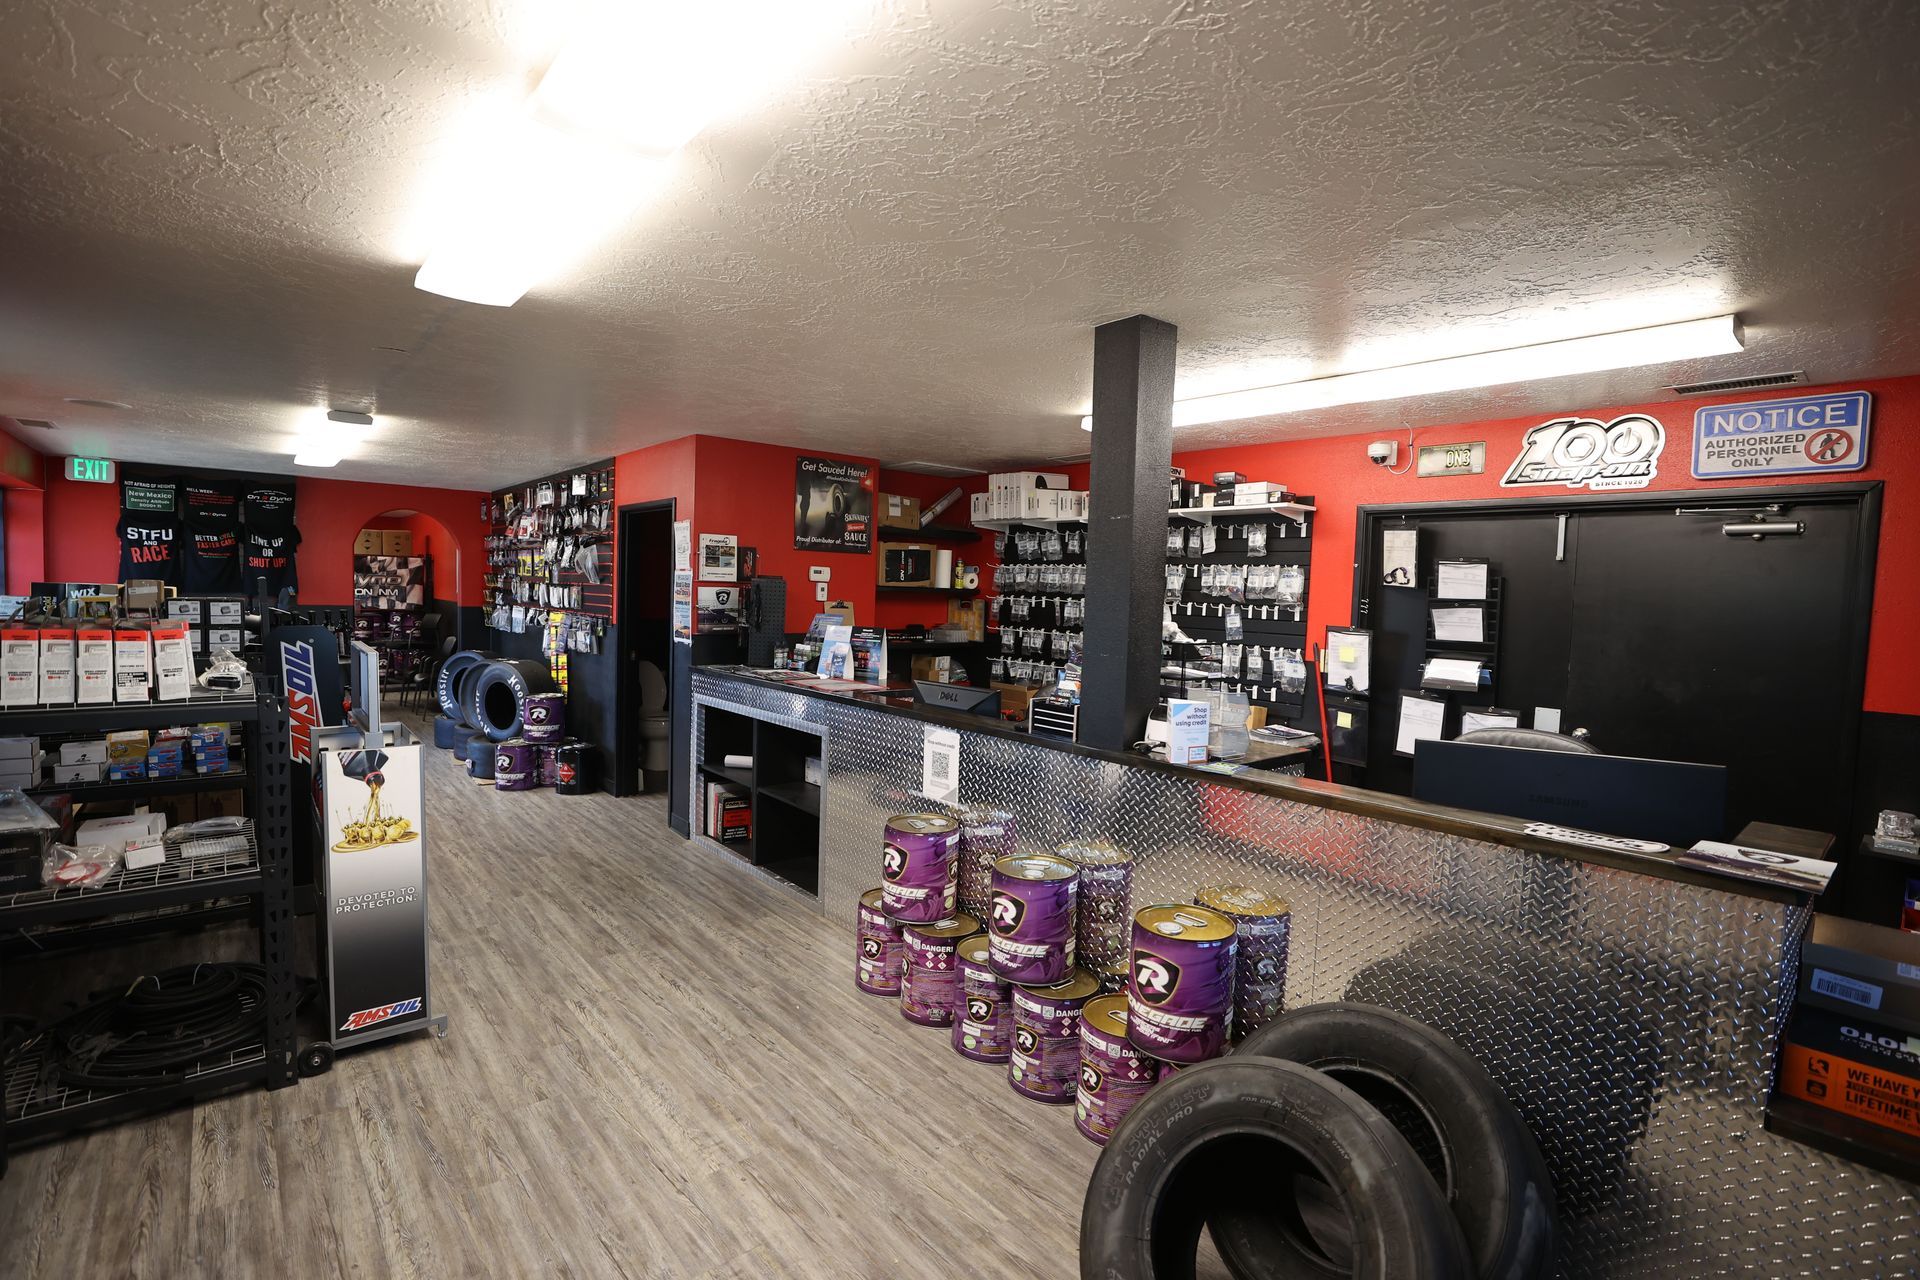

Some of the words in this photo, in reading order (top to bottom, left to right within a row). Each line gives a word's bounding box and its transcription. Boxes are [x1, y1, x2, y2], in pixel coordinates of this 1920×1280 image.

[1713, 402, 1847, 434] NOTICE
[1705, 433, 1806, 450] AUTHORIZED
[1446, 449, 1471, 468] ON3
[1707, 445, 1802, 460] PERSONNEL
[73, 458, 109, 481] EXIT
[802, 461, 816, 471] Get
[818, 463, 846, 475] Sauced
[847, 467, 868, 478] Here!
[1731, 457, 1774, 468] ONLY
[147, 491, 172, 499] Mexico
[127, 527, 173, 541] STFU
[194, 534, 218, 542] BETTER
[250, 534, 269, 547] LINE
[272, 538, 284, 547] UP
[844, 532, 867, 542] SAUCE
[130, 544, 171, 564] RACE
[262, 548, 274, 557] OR
[249, 556, 269, 568] SHUT
[272, 557, 287, 568] UP!
[70, 588, 97, 599] WIX
[379, 588, 399, 597] NM
[280, 639, 319, 765] AMSOIL
[335, 894, 417, 914] PROTECTION.
[338, 889, 396, 905] DEVOTED
[400, 886, 416, 895] TO
[993, 897, 1017, 926] R
[921, 943, 954, 953] DANGER!
[1136, 958, 1170, 995] R
[339, 997, 423, 1032] AMSOIL
[1847, 1067, 1870, 1085] WE
[1873, 1076, 1910, 1096] HAVE
[1260, 1098, 1283, 1110] DRAG
[1286, 1106, 1315, 1127] RACING
[1845, 1090, 1910, 1122] LIFETIME
[1125, 1130, 1165, 1185] RADIAL
[1166, 1105, 1193, 1129] PRO
